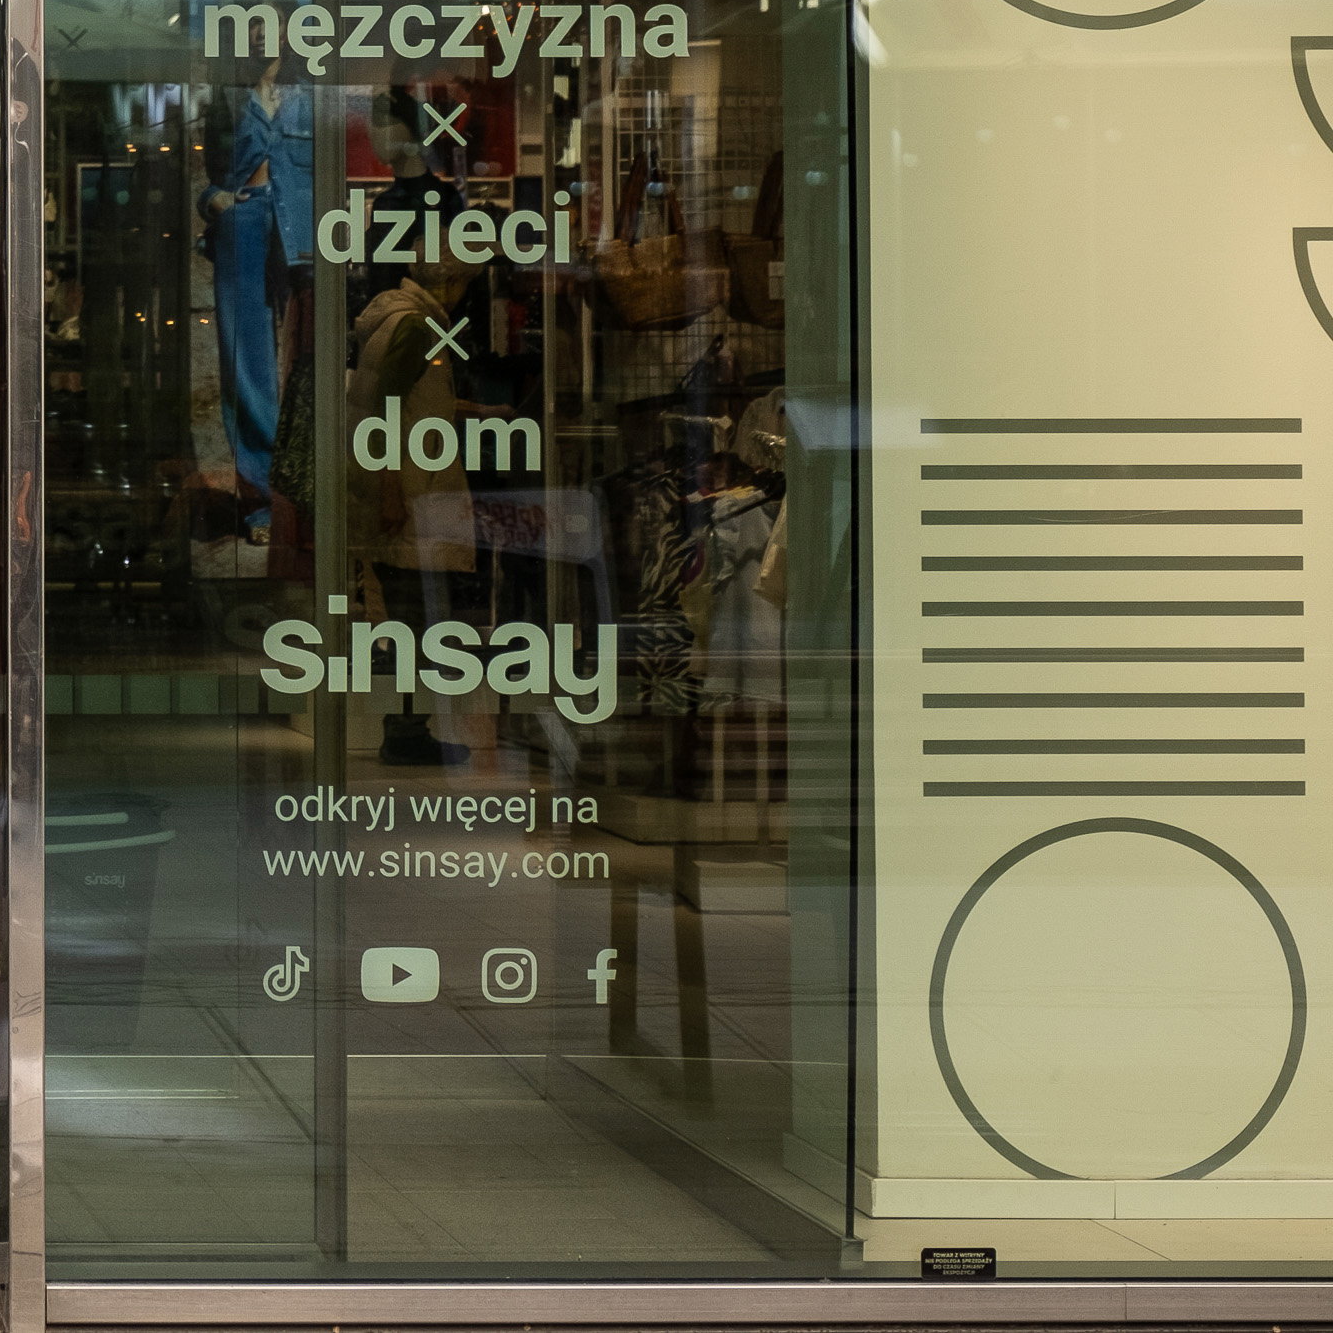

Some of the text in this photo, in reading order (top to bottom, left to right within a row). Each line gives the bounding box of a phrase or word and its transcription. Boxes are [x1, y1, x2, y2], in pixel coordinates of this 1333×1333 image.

[316, 188, 571, 264] dzieci
[352, 395, 541, 472] dom
[259, 594, 619, 725] sinsay
[275, 785, 396, 832] odkryj
[551, 796, 599, 824] na
[84, 872, 126, 889] sinsay
[263, 843, 609, 888] www.sinsay.com
